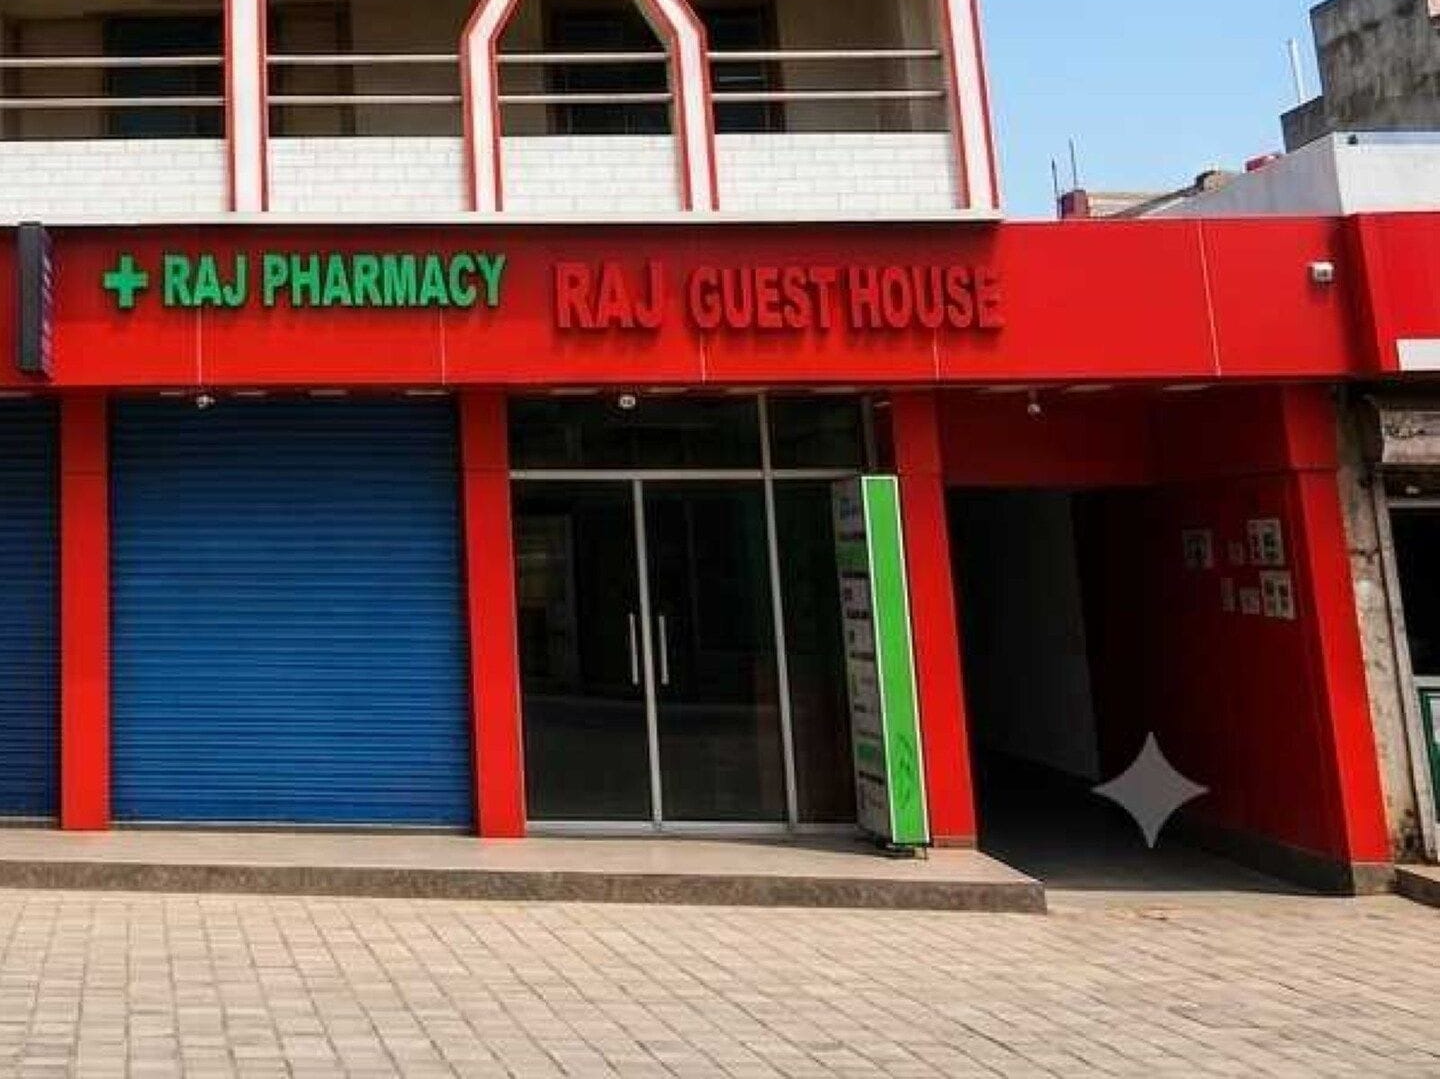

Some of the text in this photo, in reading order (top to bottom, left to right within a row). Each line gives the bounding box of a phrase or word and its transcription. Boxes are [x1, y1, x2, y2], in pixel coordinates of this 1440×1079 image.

[163, 251, 506, 307] RAJ PHARMACY
[555, 260, 1008, 330] RAJ GUEST HOUSE
